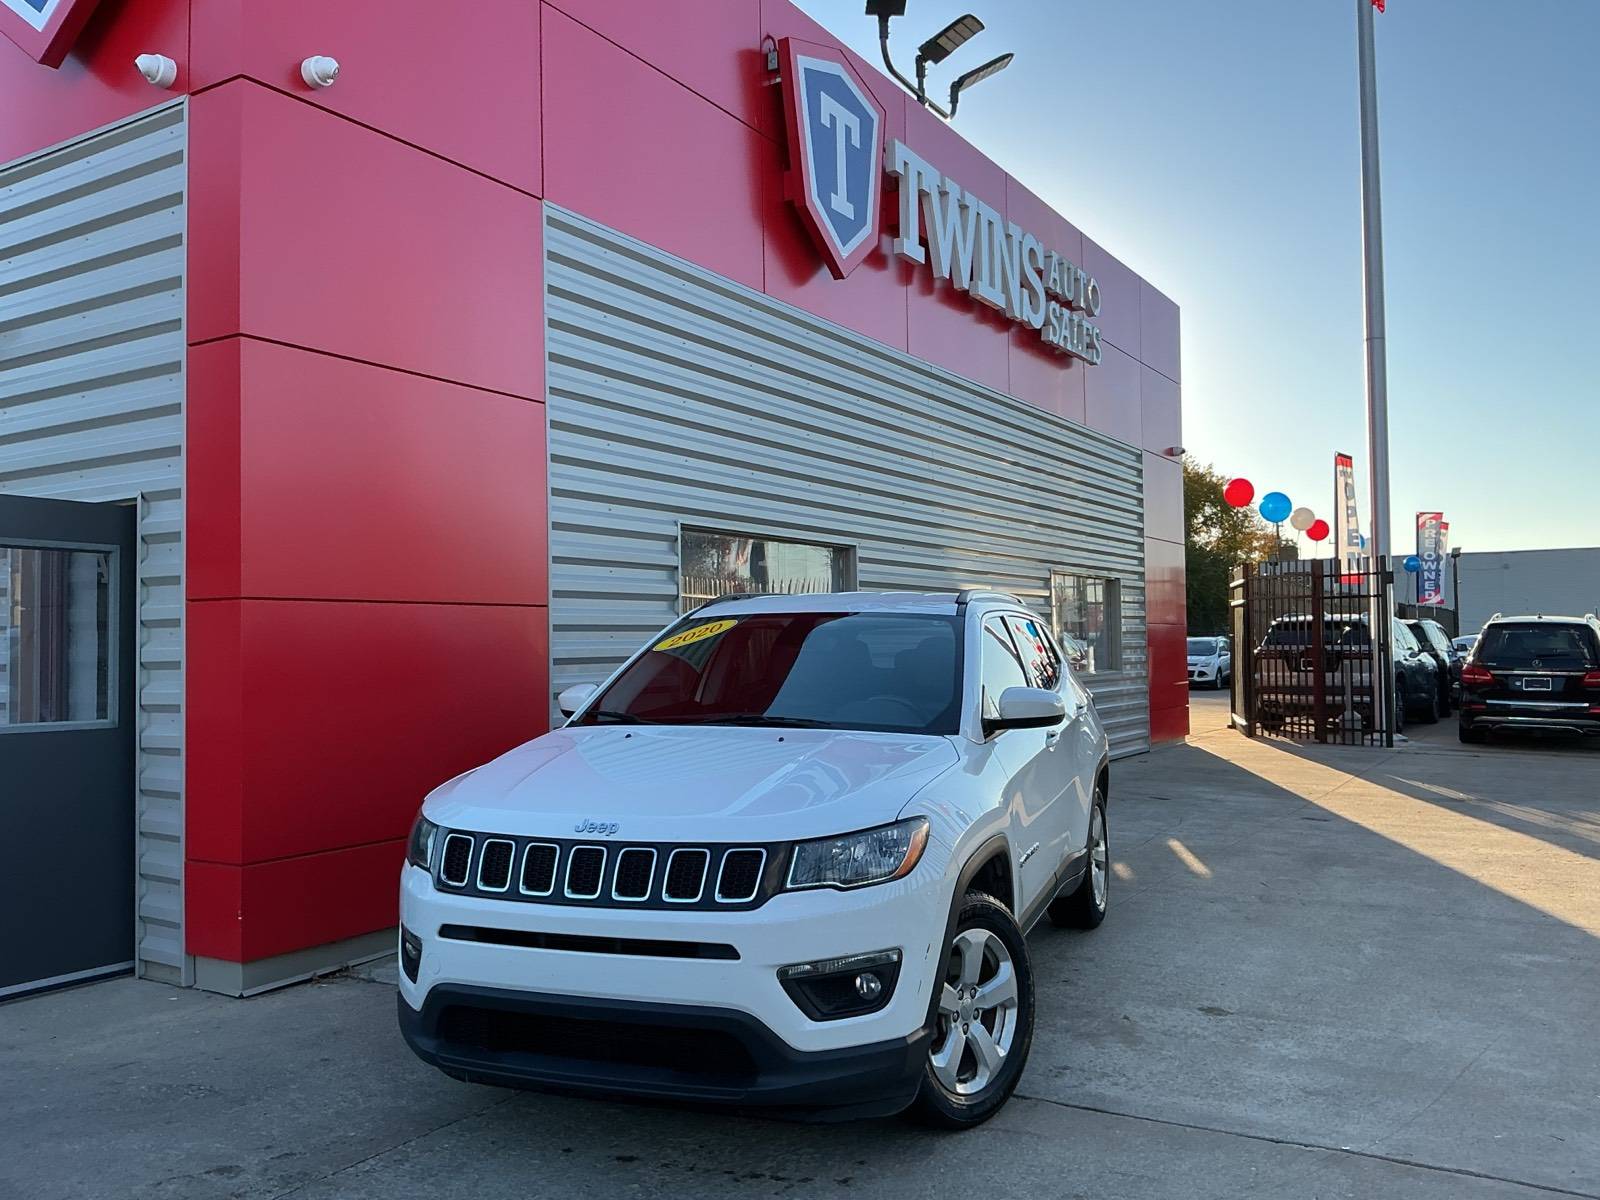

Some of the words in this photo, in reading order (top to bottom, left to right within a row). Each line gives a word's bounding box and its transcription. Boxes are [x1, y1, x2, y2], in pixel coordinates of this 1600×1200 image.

[820, 91, 861, 221] T
[887, 139, 1047, 330] TWINS
[1045, 250, 1101, 317] AUTO
[1042, 300, 1102, 366] SALES
[1424, 519, 1437, 548] PRE
[1422, 551, 1437, 600] OWNED
[667, 622, 723, 648] 2020
[574, 817, 620, 837] Jeep
